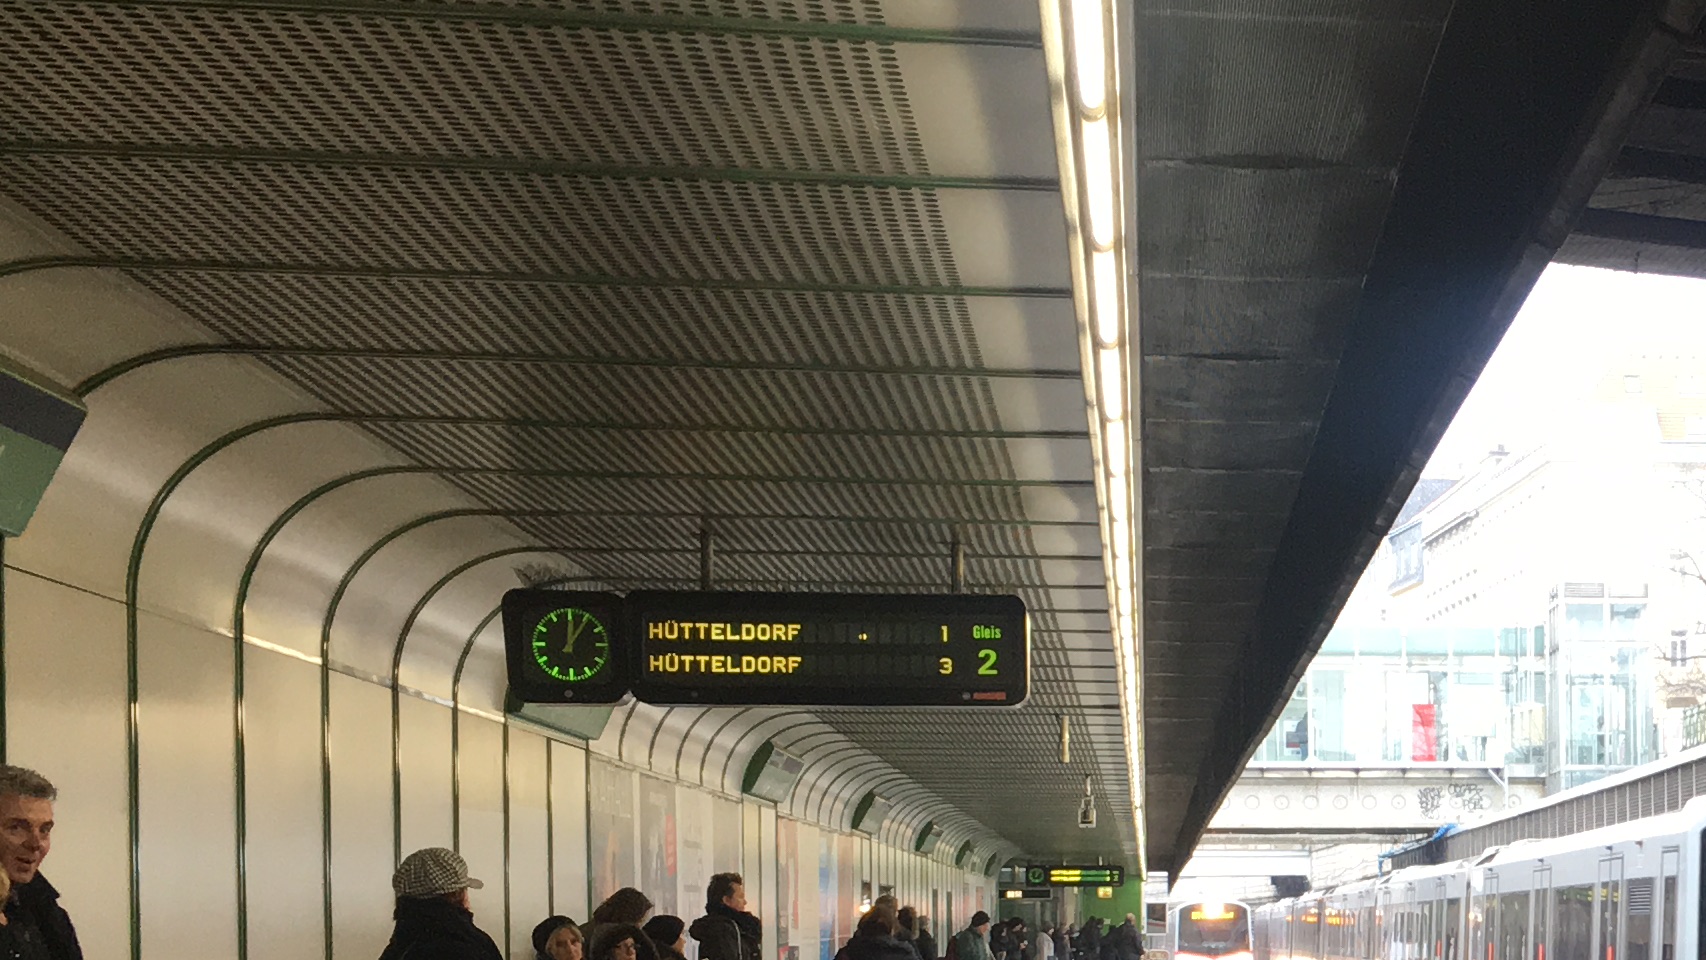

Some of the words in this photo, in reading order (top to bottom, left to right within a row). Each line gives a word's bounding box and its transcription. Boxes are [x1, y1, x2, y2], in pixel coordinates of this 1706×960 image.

[649, 620, 801, 641] HÜTTELDORF
[941, 626, 949, 642] 1
[973, 625, 1001, 639] Gleis
[649, 653, 801, 674] HÜTTELDORF
[939, 658, 952, 674] 3
[978, 649, 998, 675] 2
